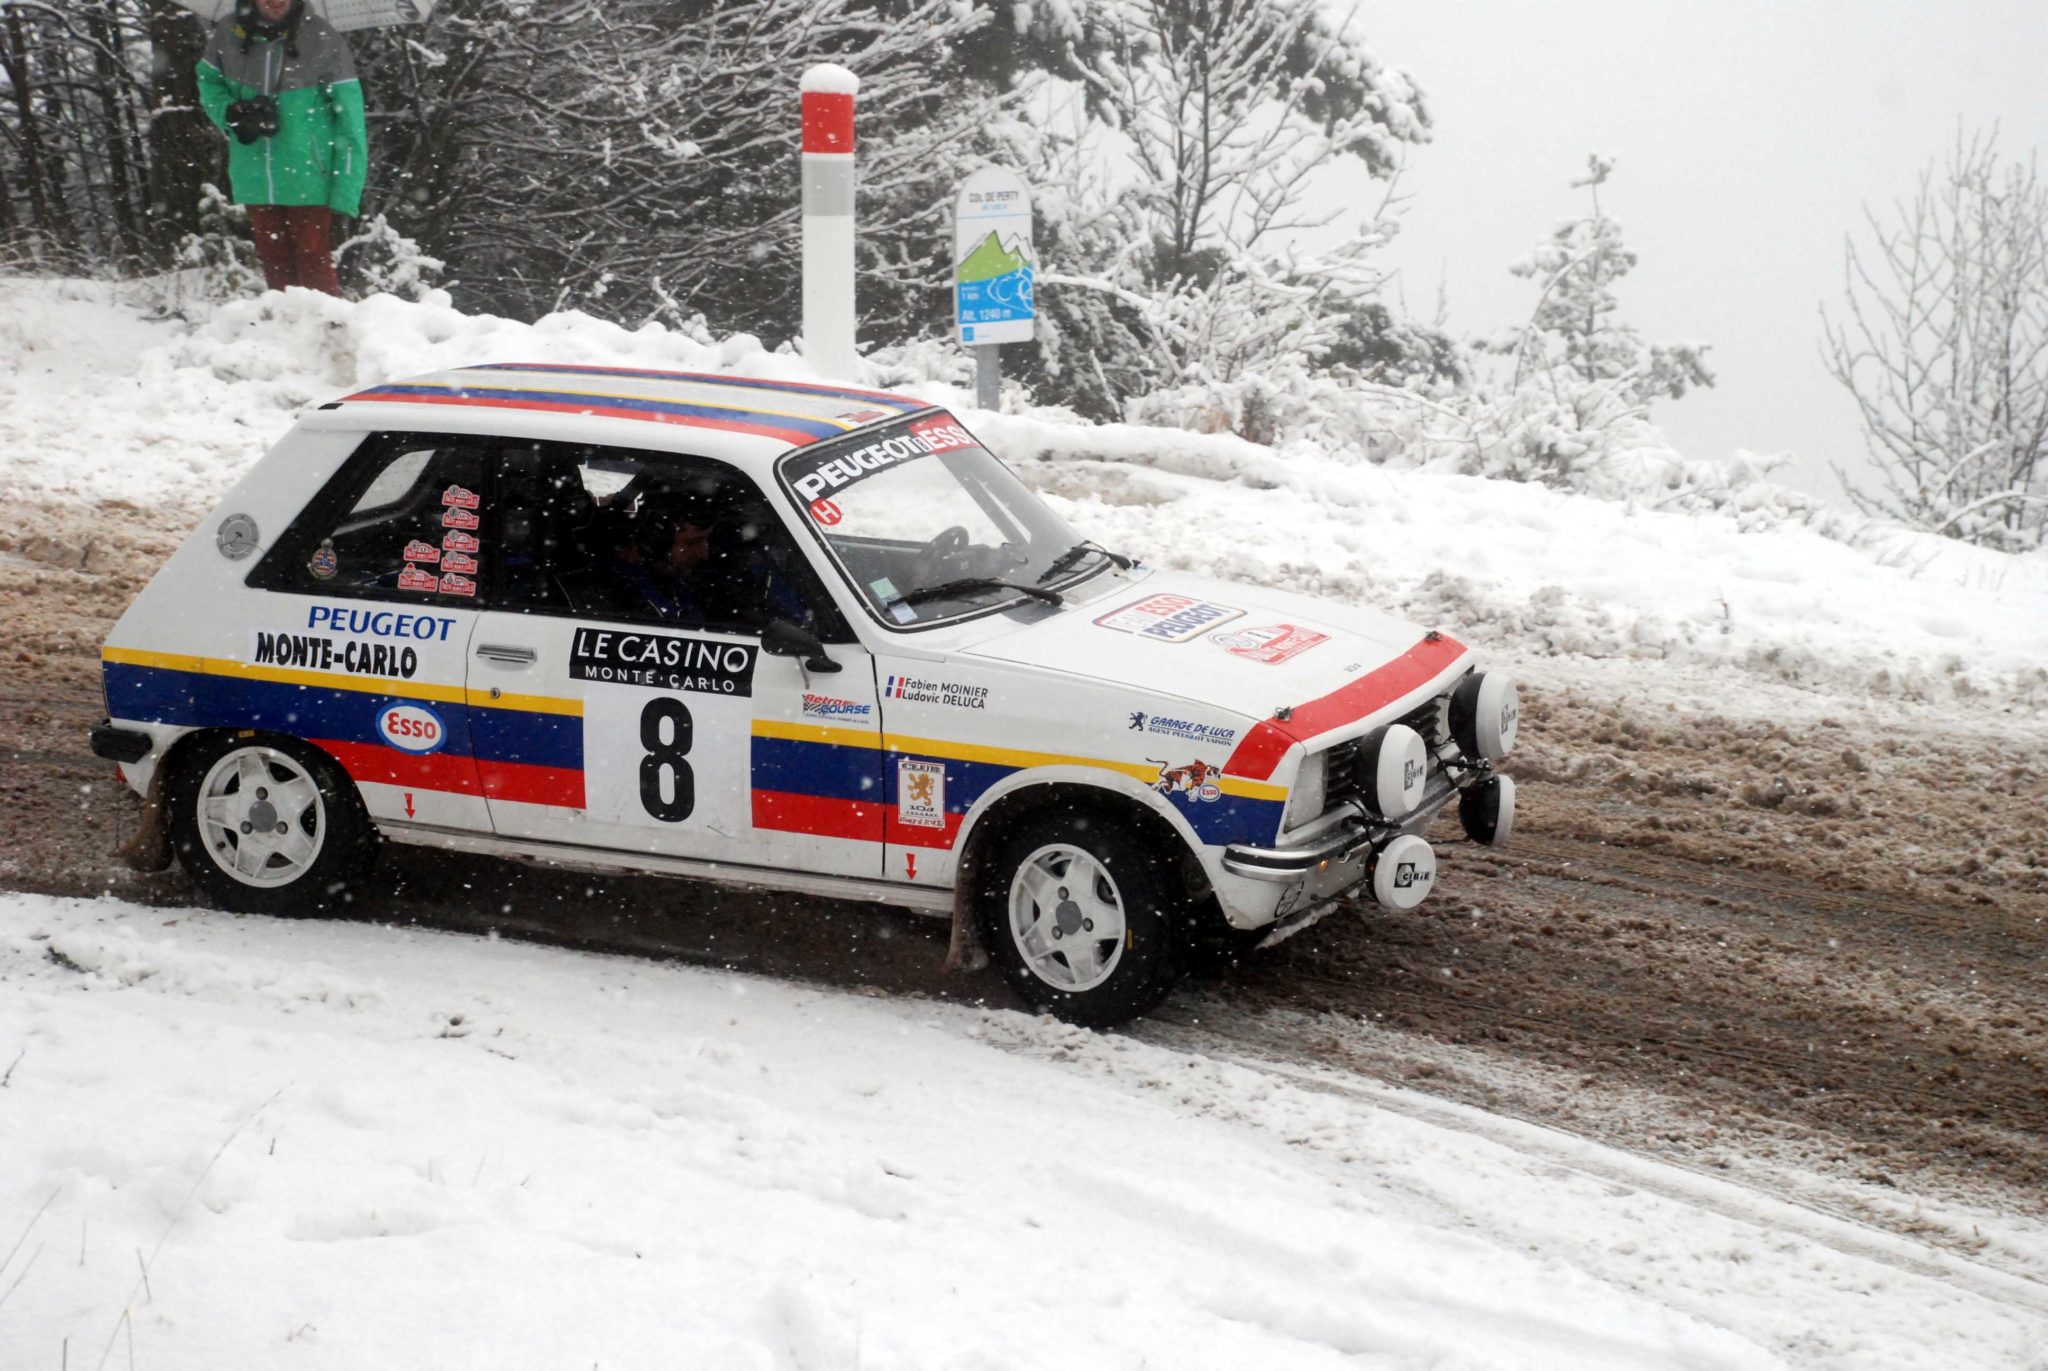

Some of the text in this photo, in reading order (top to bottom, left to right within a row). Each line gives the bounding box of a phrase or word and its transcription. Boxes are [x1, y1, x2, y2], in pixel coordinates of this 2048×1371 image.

[969, 191, 1019, 203] COL DE PERTY
[793, 425, 973, 502] PEUGEOT ESS
[812, 501, 840, 524] H
[1136, 596, 1196, 617] ESSO
[308, 606, 456, 641] PEUGEOT
[1142, 603, 1232, 638] PEUGEOT
[255, 632, 418, 679] MONTE-CARLO
[577, 631, 748, 673] LE CASINO
[902, 689, 986, 710] Ludovic DELUCA
[904, 678, 989, 698] Fabien MOINIER
[820, 704, 871, 715] COURSE
[387, 711, 436, 741] Esso
[1151, 717, 1234, 736] GARAGE DE LUCA
[639, 697, 695, 823] 8
[1202, 788, 1217, 796] Esso
